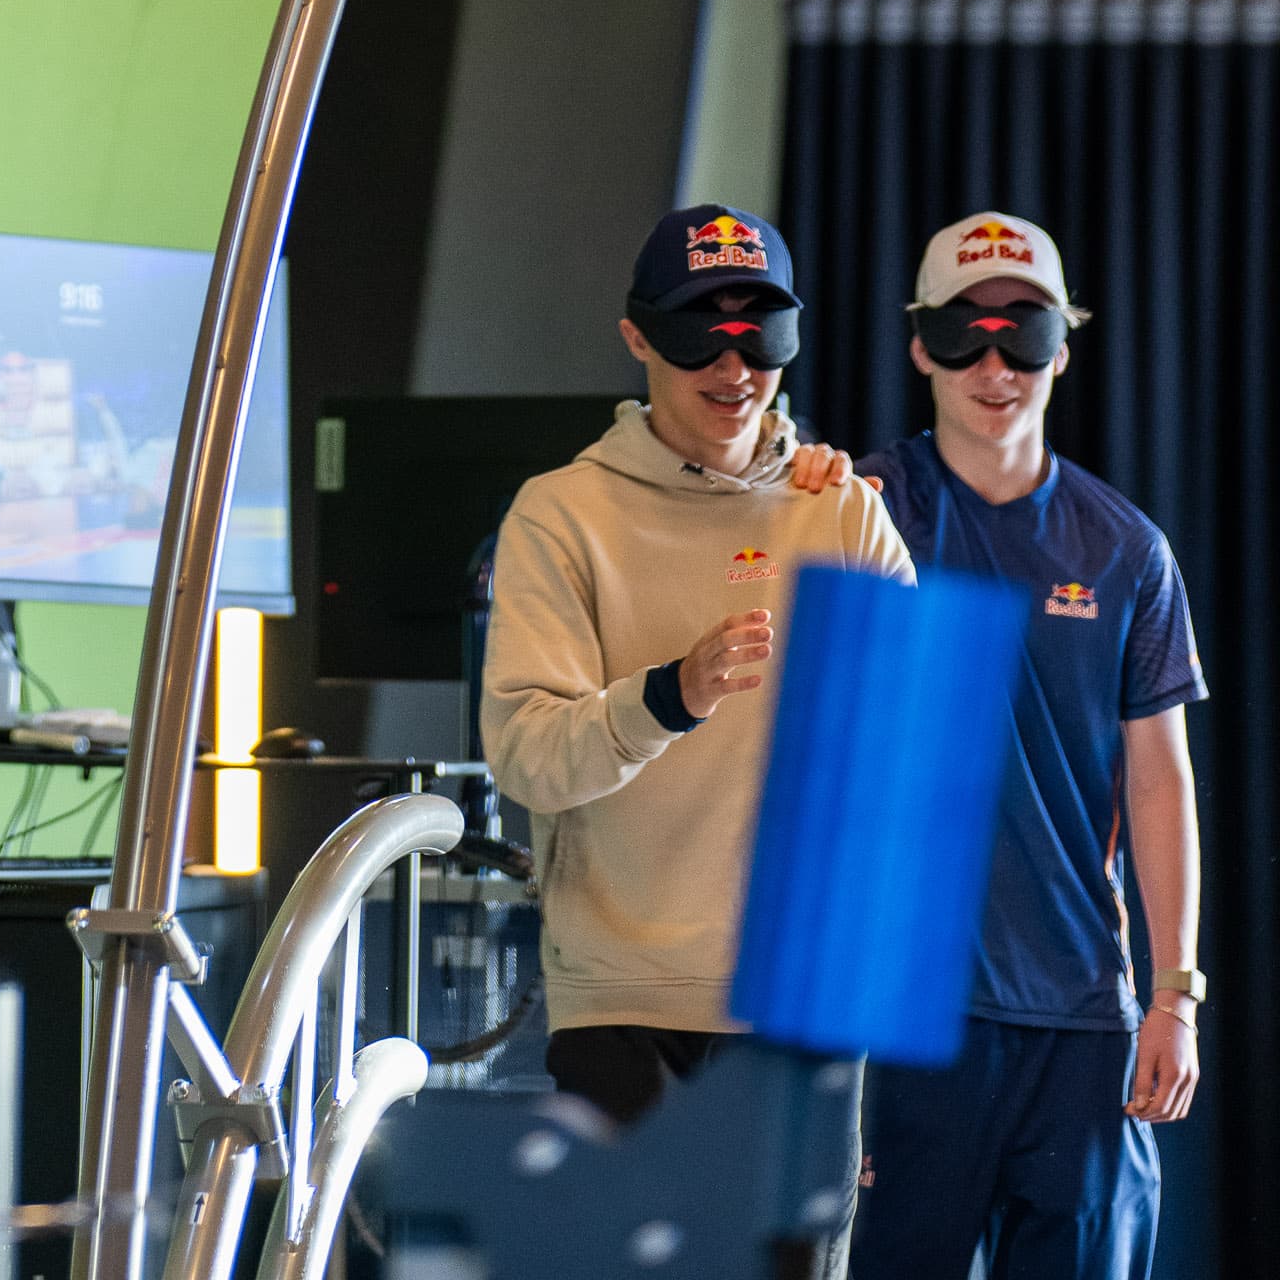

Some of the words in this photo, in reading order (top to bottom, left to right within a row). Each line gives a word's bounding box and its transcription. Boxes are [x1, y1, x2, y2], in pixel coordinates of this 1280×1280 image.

[688, 245, 730, 271] Red
[957, 243, 993, 266] Red
[998, 244, 1034, 265] Bull
